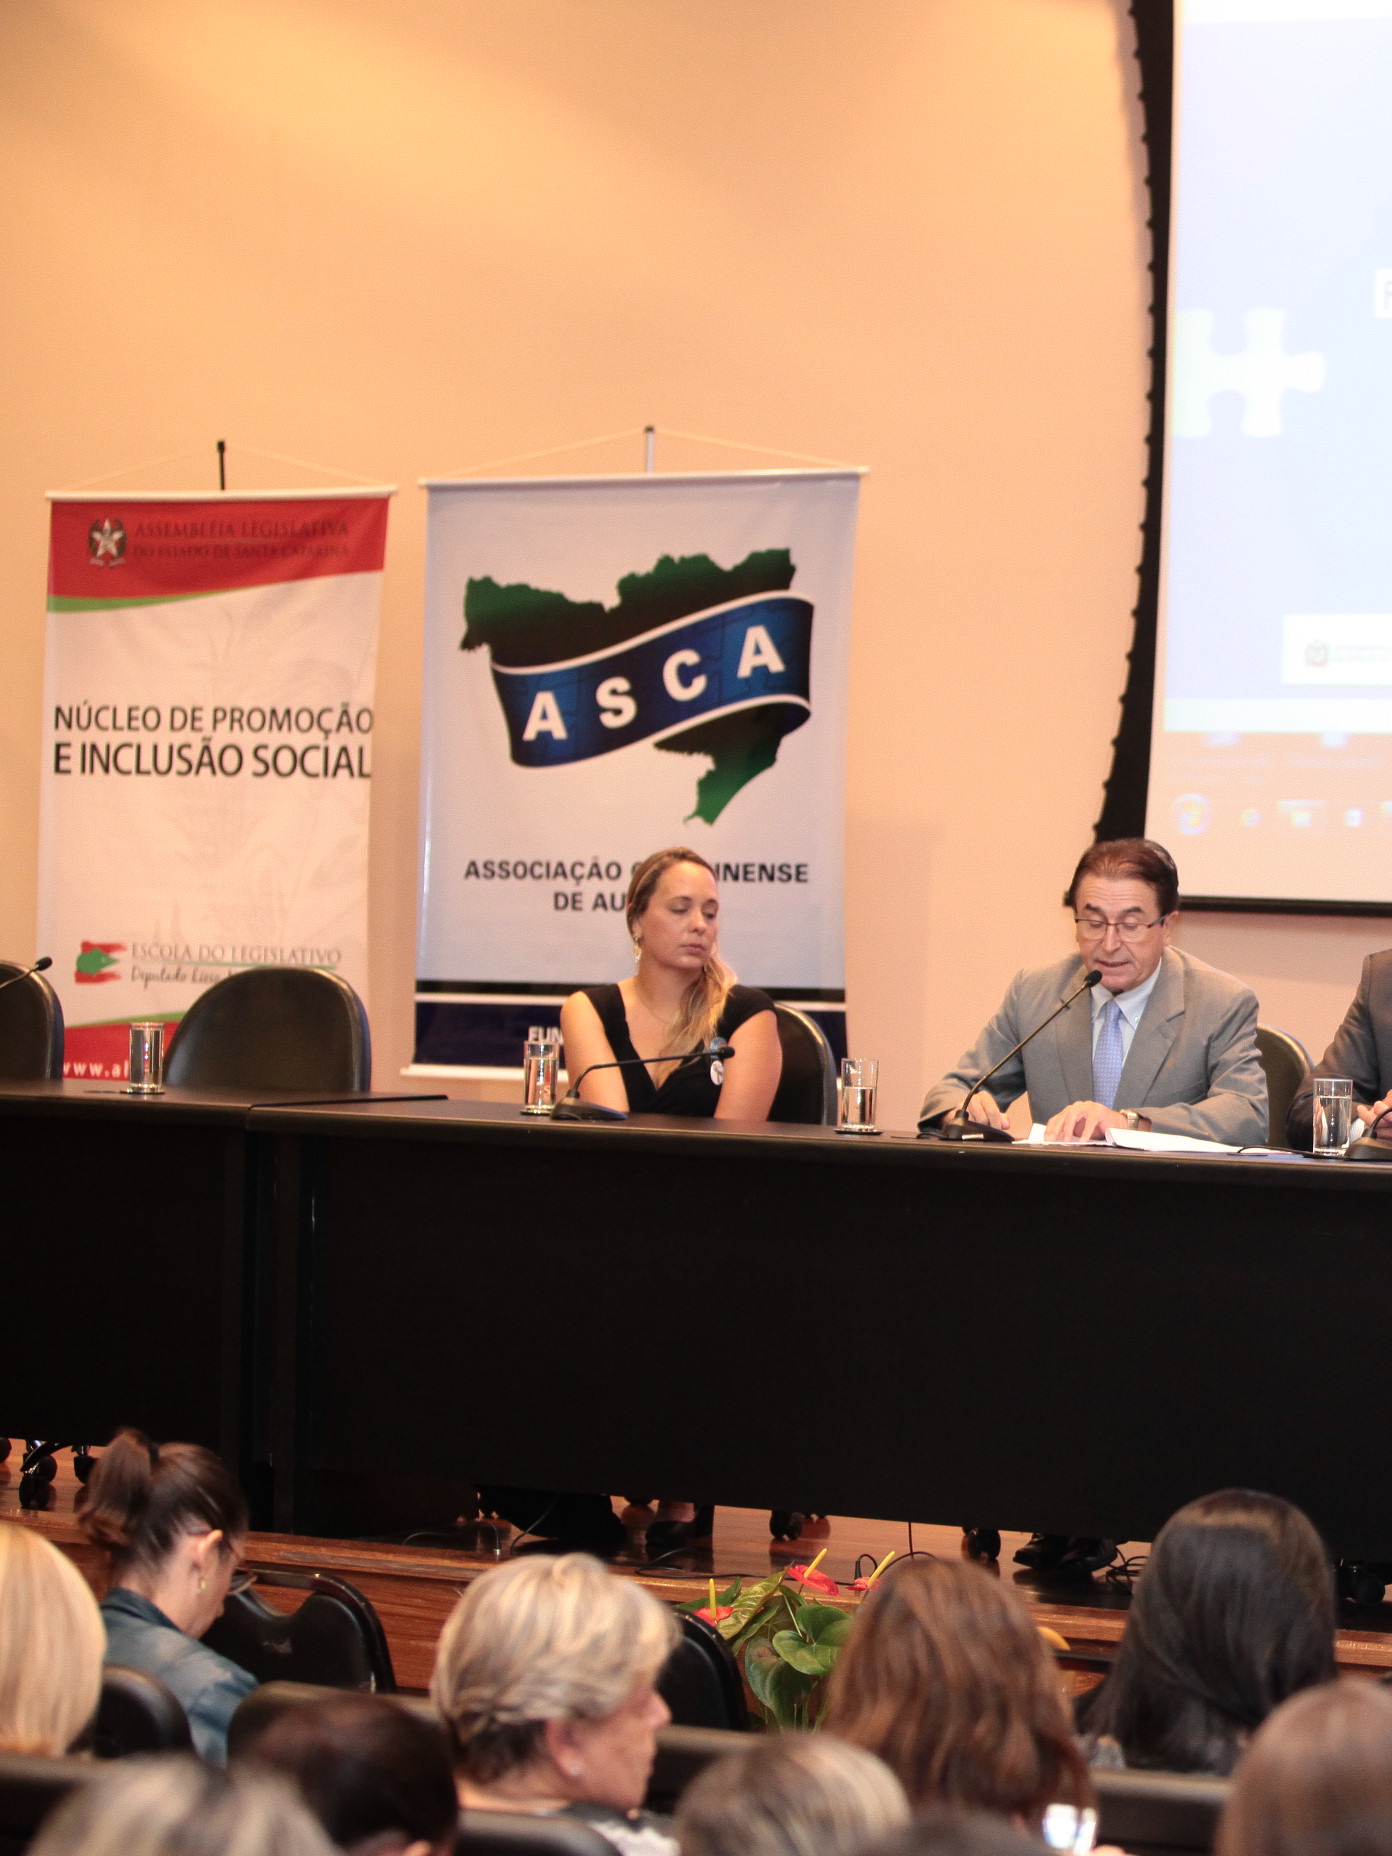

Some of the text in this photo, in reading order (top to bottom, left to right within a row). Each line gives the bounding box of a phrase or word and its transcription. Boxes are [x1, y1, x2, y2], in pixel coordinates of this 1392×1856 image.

[522, 624, 785, 741] ASCA
[53, 701, 374, 740] NÚCLEO DE PROMOÇÃO
[53, 738, 372, 778] E INCLUSÃO SOCIAL
[464, 857, 622, 885] ASSOCIAÇÃO
[553, 892, 583, 911] DE
